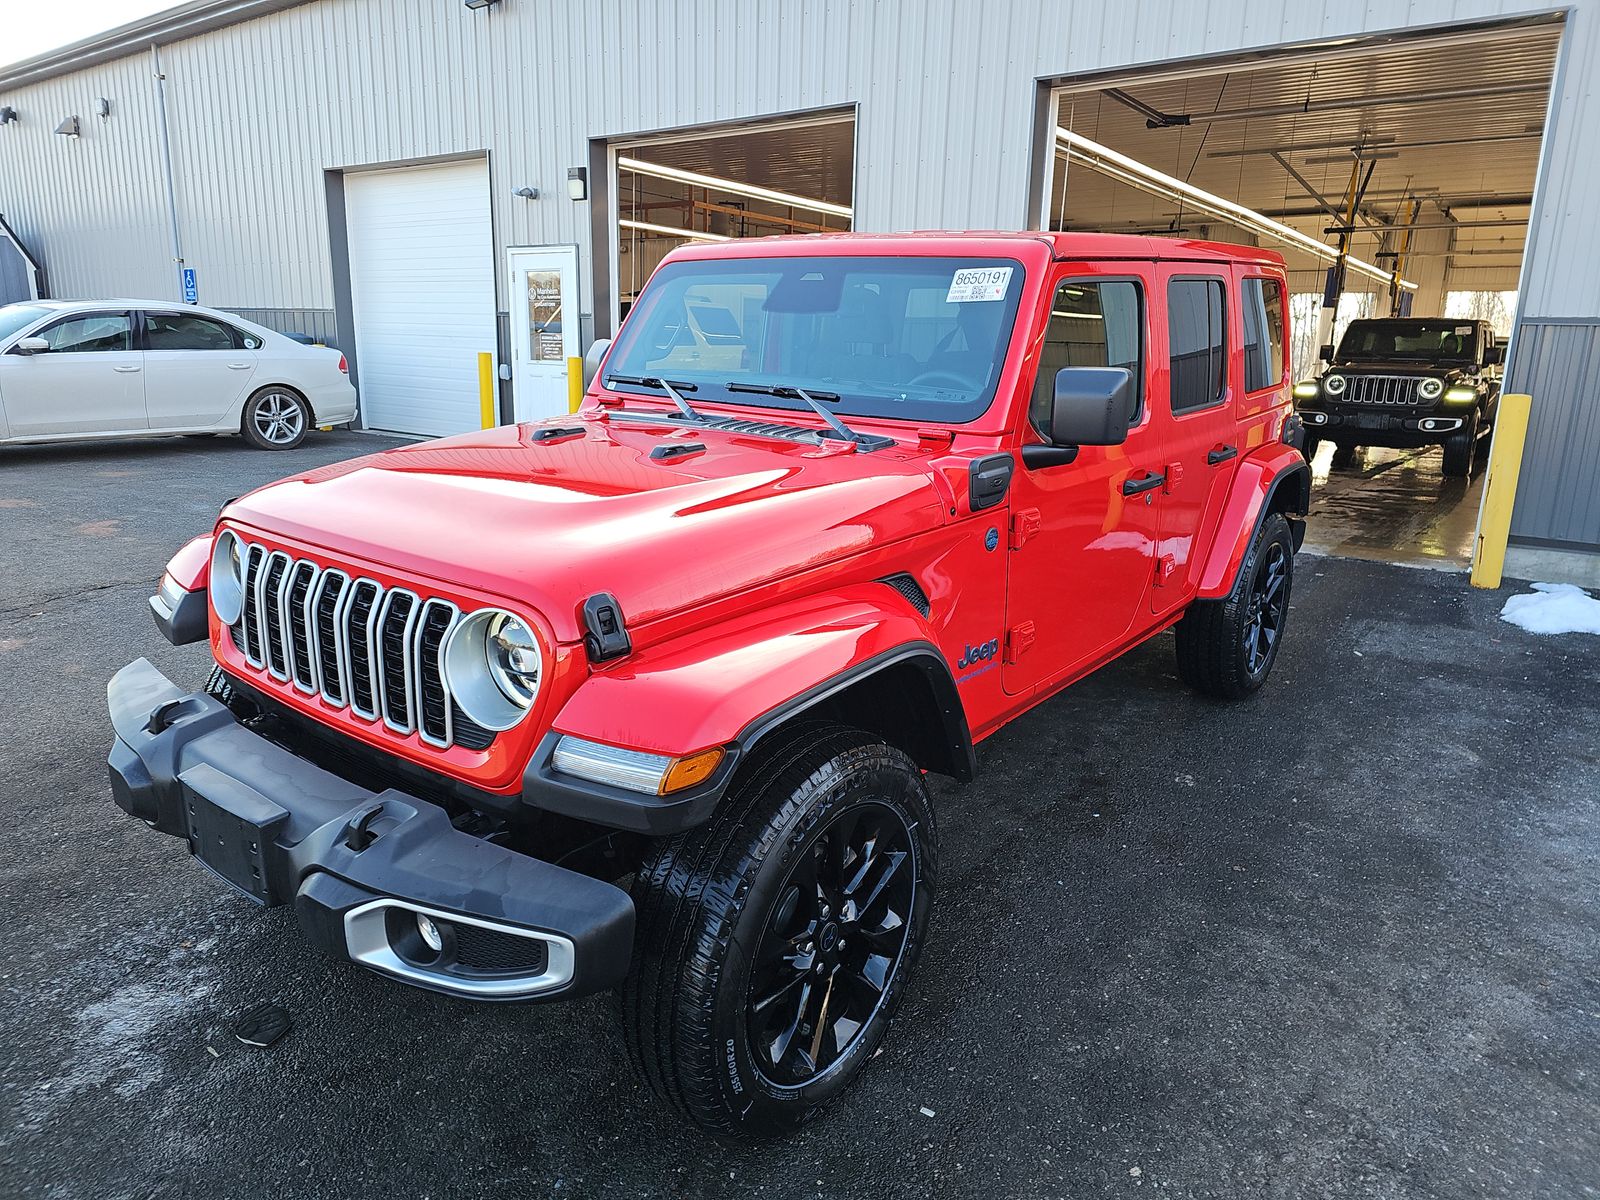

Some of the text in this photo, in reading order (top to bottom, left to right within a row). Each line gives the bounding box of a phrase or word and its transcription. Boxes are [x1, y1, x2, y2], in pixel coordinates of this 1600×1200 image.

[956, 271, 1007, 286] 8650191
[957, 637, 999, 670] Jeep
[726, 1039, 744, 1095] 255/60R20
